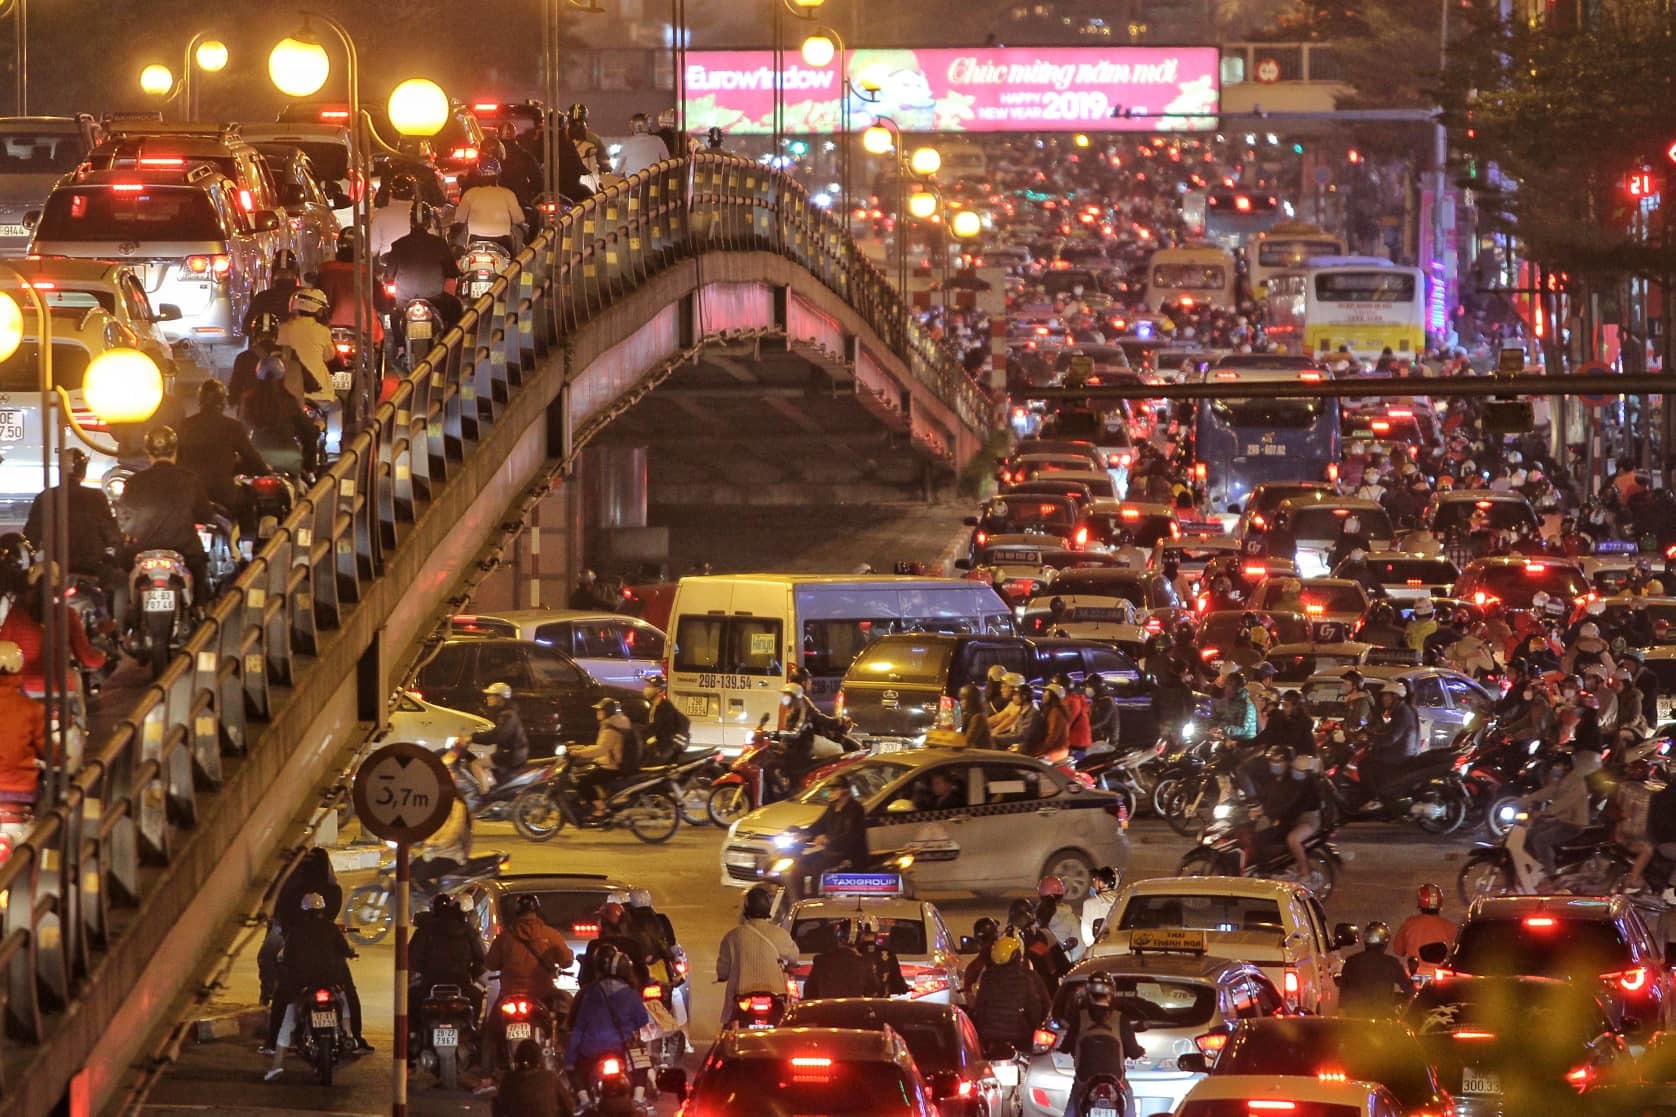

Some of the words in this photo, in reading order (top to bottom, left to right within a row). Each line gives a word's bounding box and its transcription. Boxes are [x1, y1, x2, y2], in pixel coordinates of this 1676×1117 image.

[1042, 91, 1108, 120] 2019
[979, 107, 1008, 120] NEW
[1010, 107, 1042, 120] YEAR
[1630, 175, 1649, 194] 21
[1247, 541, 1262, 554] G7
[1320, 624, 1335, 639] G7
[698, 674, 751, 689] 29B-139.54
[1463, 1080, 1500, 1092] 300.33
